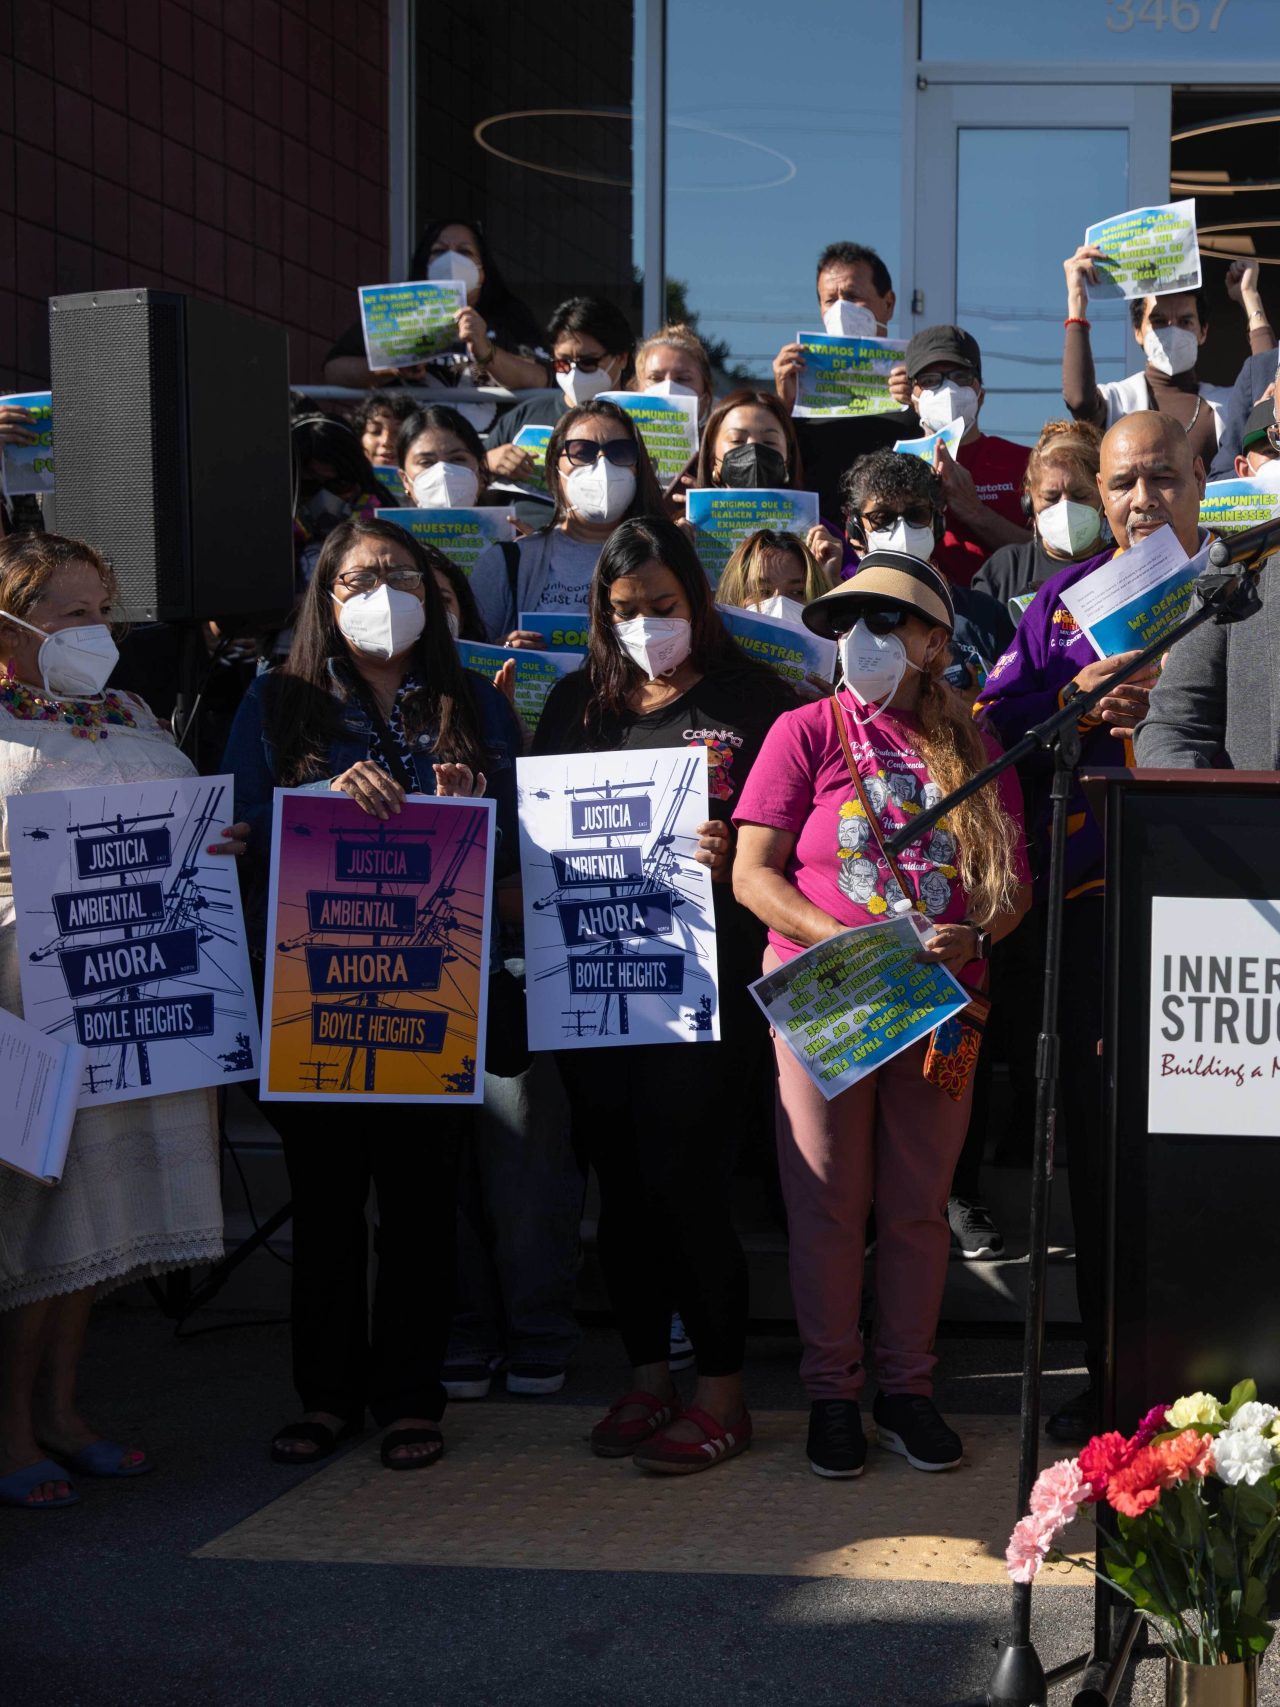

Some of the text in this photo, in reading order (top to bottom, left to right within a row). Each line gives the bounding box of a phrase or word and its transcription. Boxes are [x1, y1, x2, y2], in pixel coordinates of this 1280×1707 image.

[1105, 0, 1229, 33] 3467
[761, 500, 778, 509] QUE
[1200, 494, 1278, 507] OMMUNITIES
[412, 523, 479, 535] NUESTRAS
[1199, 509, 1271, 522] BUSINESSES
[541, 593, 570, 605] East
[1128, 612, 1149, 631] WE
[1140, 599, 1192, 641] IMMEDIA
[552, 630, 589, 645] SOM
[732, 635, 804, 663] NUESTRAS
[522, 663, 556, 673] QUE SE
[581, 804, 631, 831] JUSTICIA
[89, 837, 148, 871] JUSTICIA
[346, 849, 407, 875] JUSTICIA
[564, 854, 628, 882] AMBIENTAL
[68, 891, 147, 927] AMBIENTAL
[319, 899, 398, 928] AMBIENTAL
[577, 903, 645, 937] AHORA
[83, 942, 167, 986] AHORA
[326, 954, 408, 984] AHORA
[575, 962, 667, 989] BOYLE HEIGHTS
[788, 941, 901, 1011] POLLUTION OF THE
[811, 992, 839, 1013] FOR
[854, 979, 887, 1004] HOLD
[83, 1003, 194, 1042] BOYLE HEIGHTS
[786, 1011, 814, 1032] THE
[803, 967, 934, 1056] AND CLEAN UP OF THE
[803, 1001, 853, 1038] LINEAGE
[818, 980, 938, 1065] AND PROPER TESTING
[319, 1010, 426, 1045] BOYLE HEIGHTS
[819, 985, 957, 1082] WE DEMAND THAT FULL
[1160, 1053, 1245, 1087] Building
[1251, 1064, 1263, 1079] a
